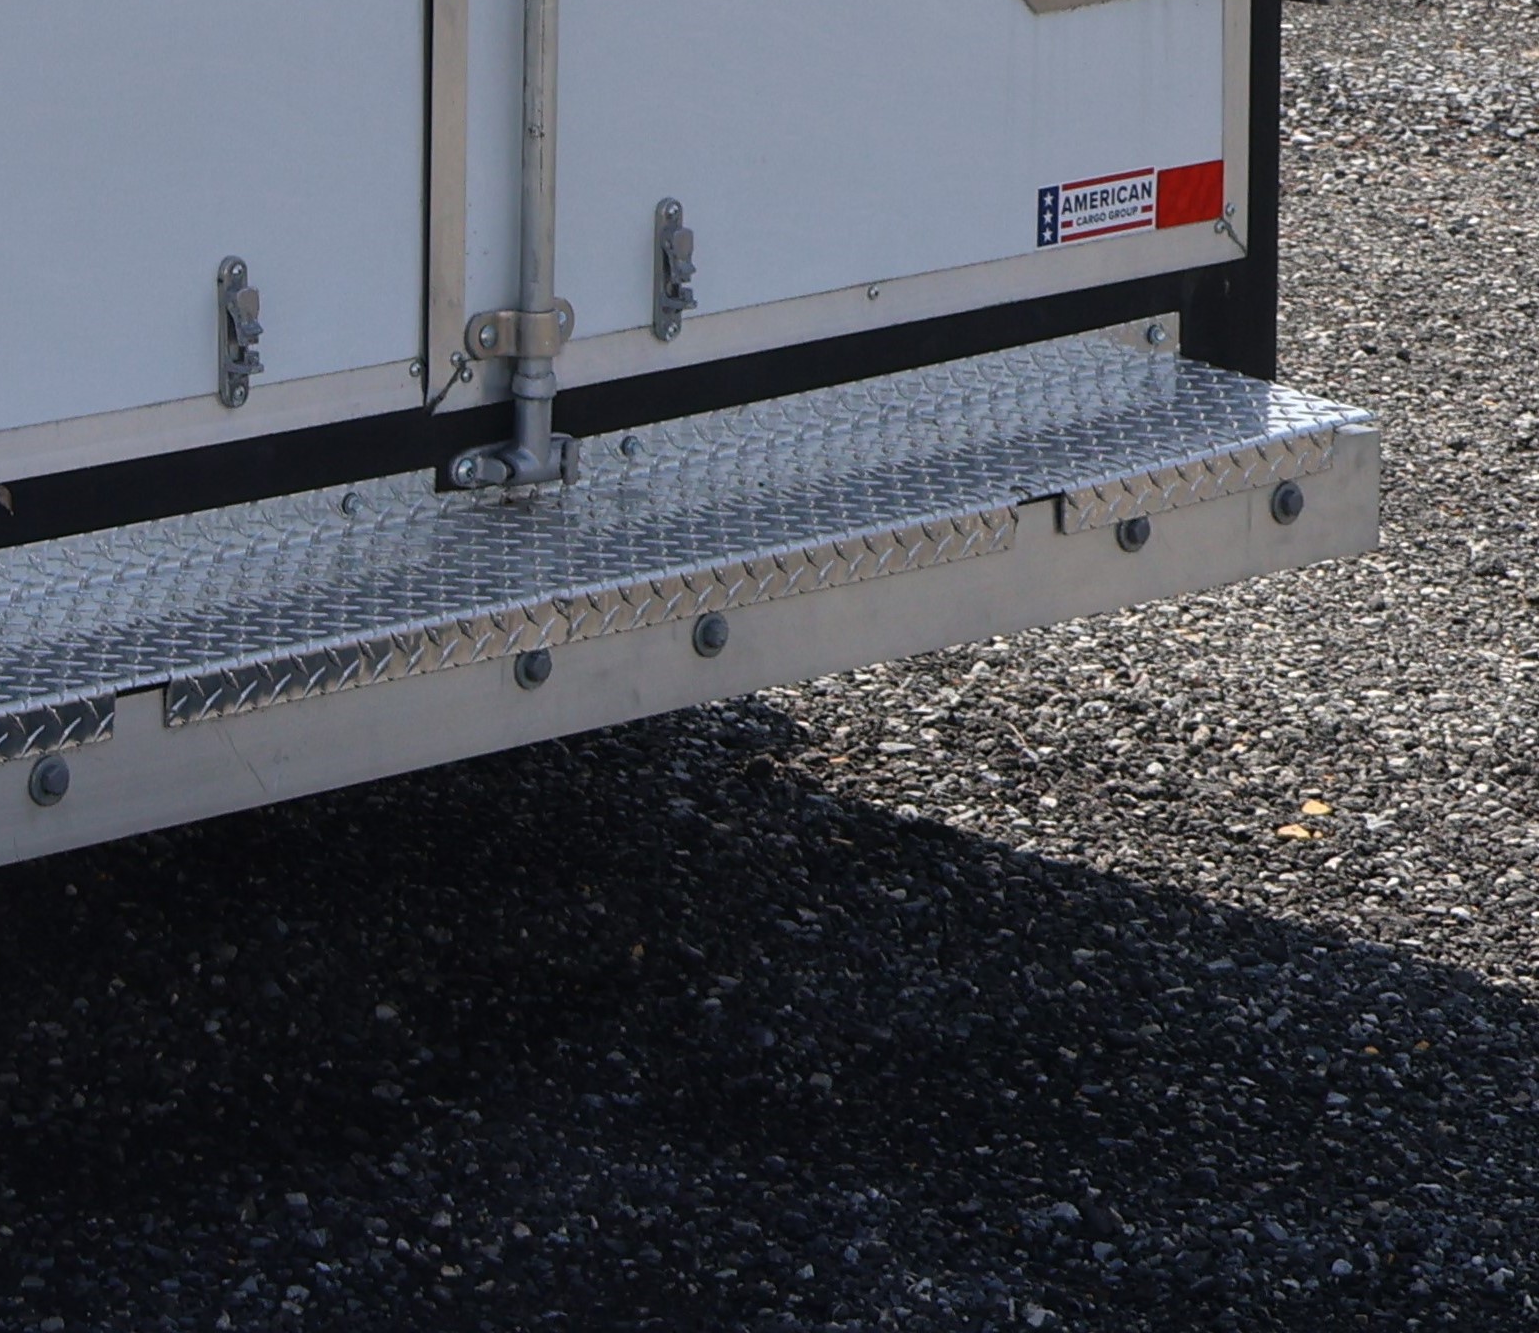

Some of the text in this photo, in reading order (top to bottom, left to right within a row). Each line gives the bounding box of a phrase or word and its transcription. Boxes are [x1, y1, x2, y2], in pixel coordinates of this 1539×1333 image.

[1062, 181, 1153, 215] AMERICAN
[1075, 205, 1139, 227] CARGO GROUP
